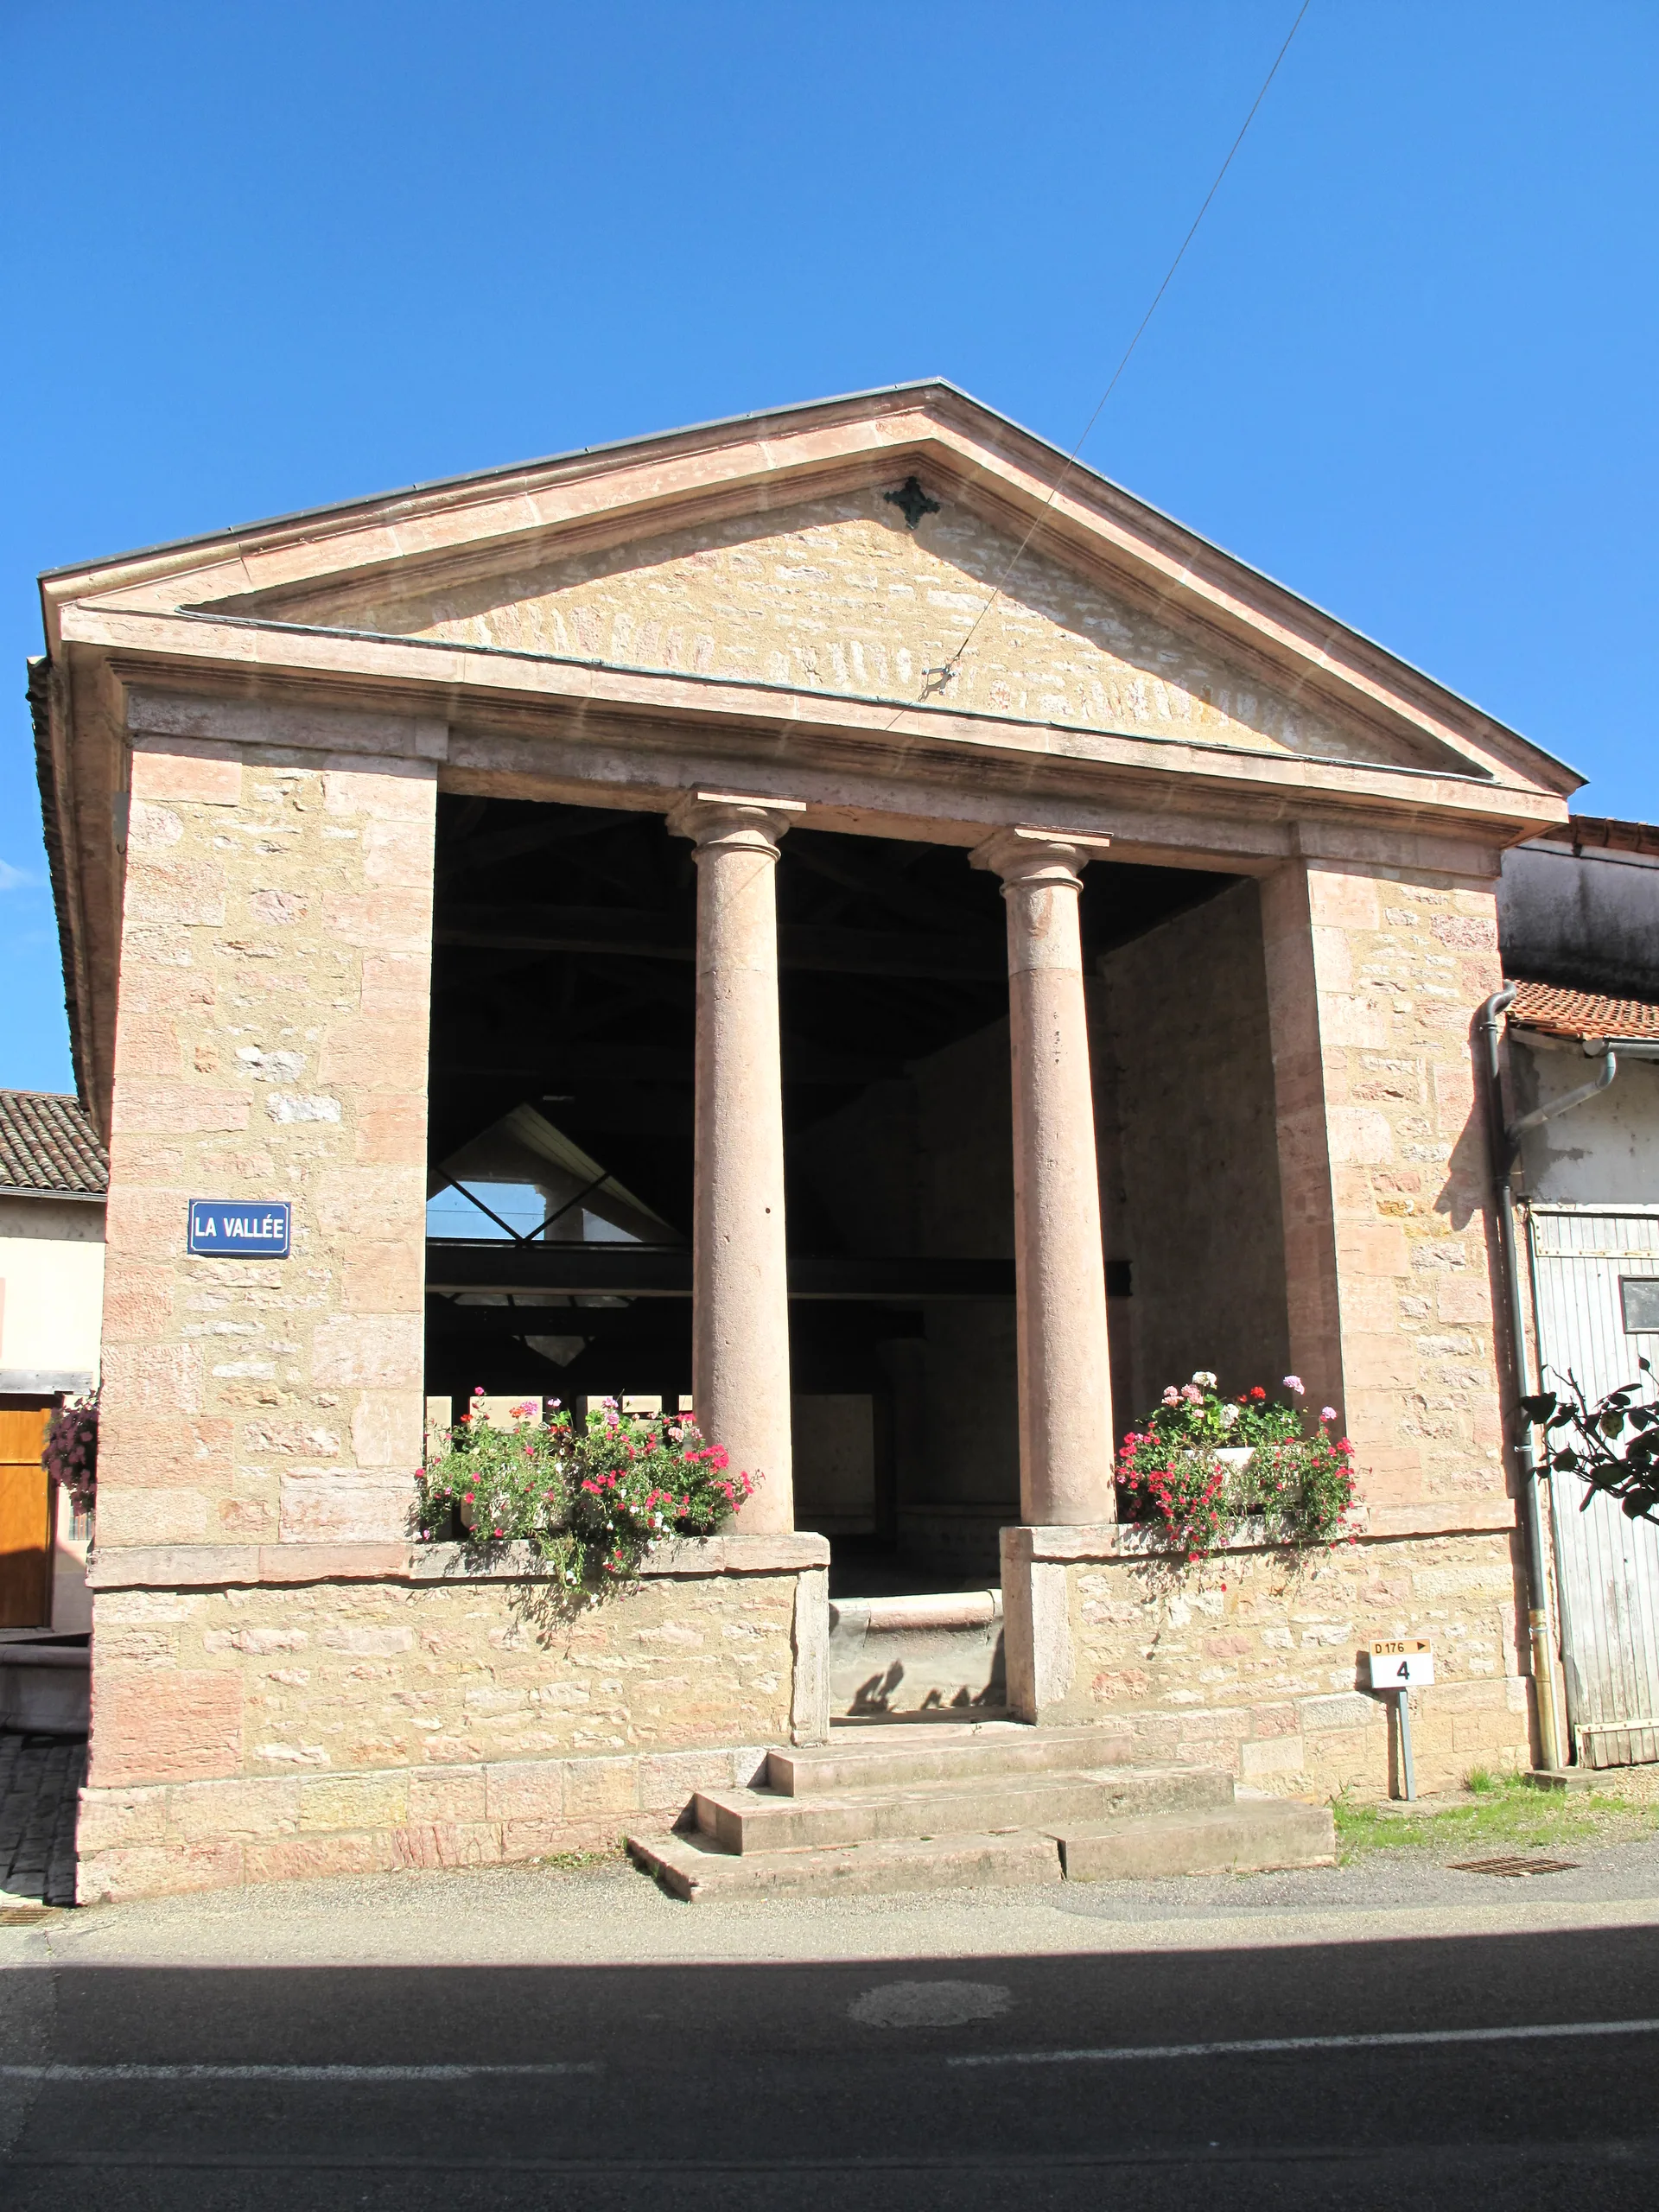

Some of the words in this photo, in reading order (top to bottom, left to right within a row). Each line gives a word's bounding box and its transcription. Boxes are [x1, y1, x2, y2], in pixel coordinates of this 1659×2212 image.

[194, 1217, 217, 1236] LA
[223, 1213, 284, 1238] VALLÉE
[1375, 1643, 1382, 1654] D
[1385, 1643, 1404, 1653] 176
[1396, 1661, 1410, 1680] 4
